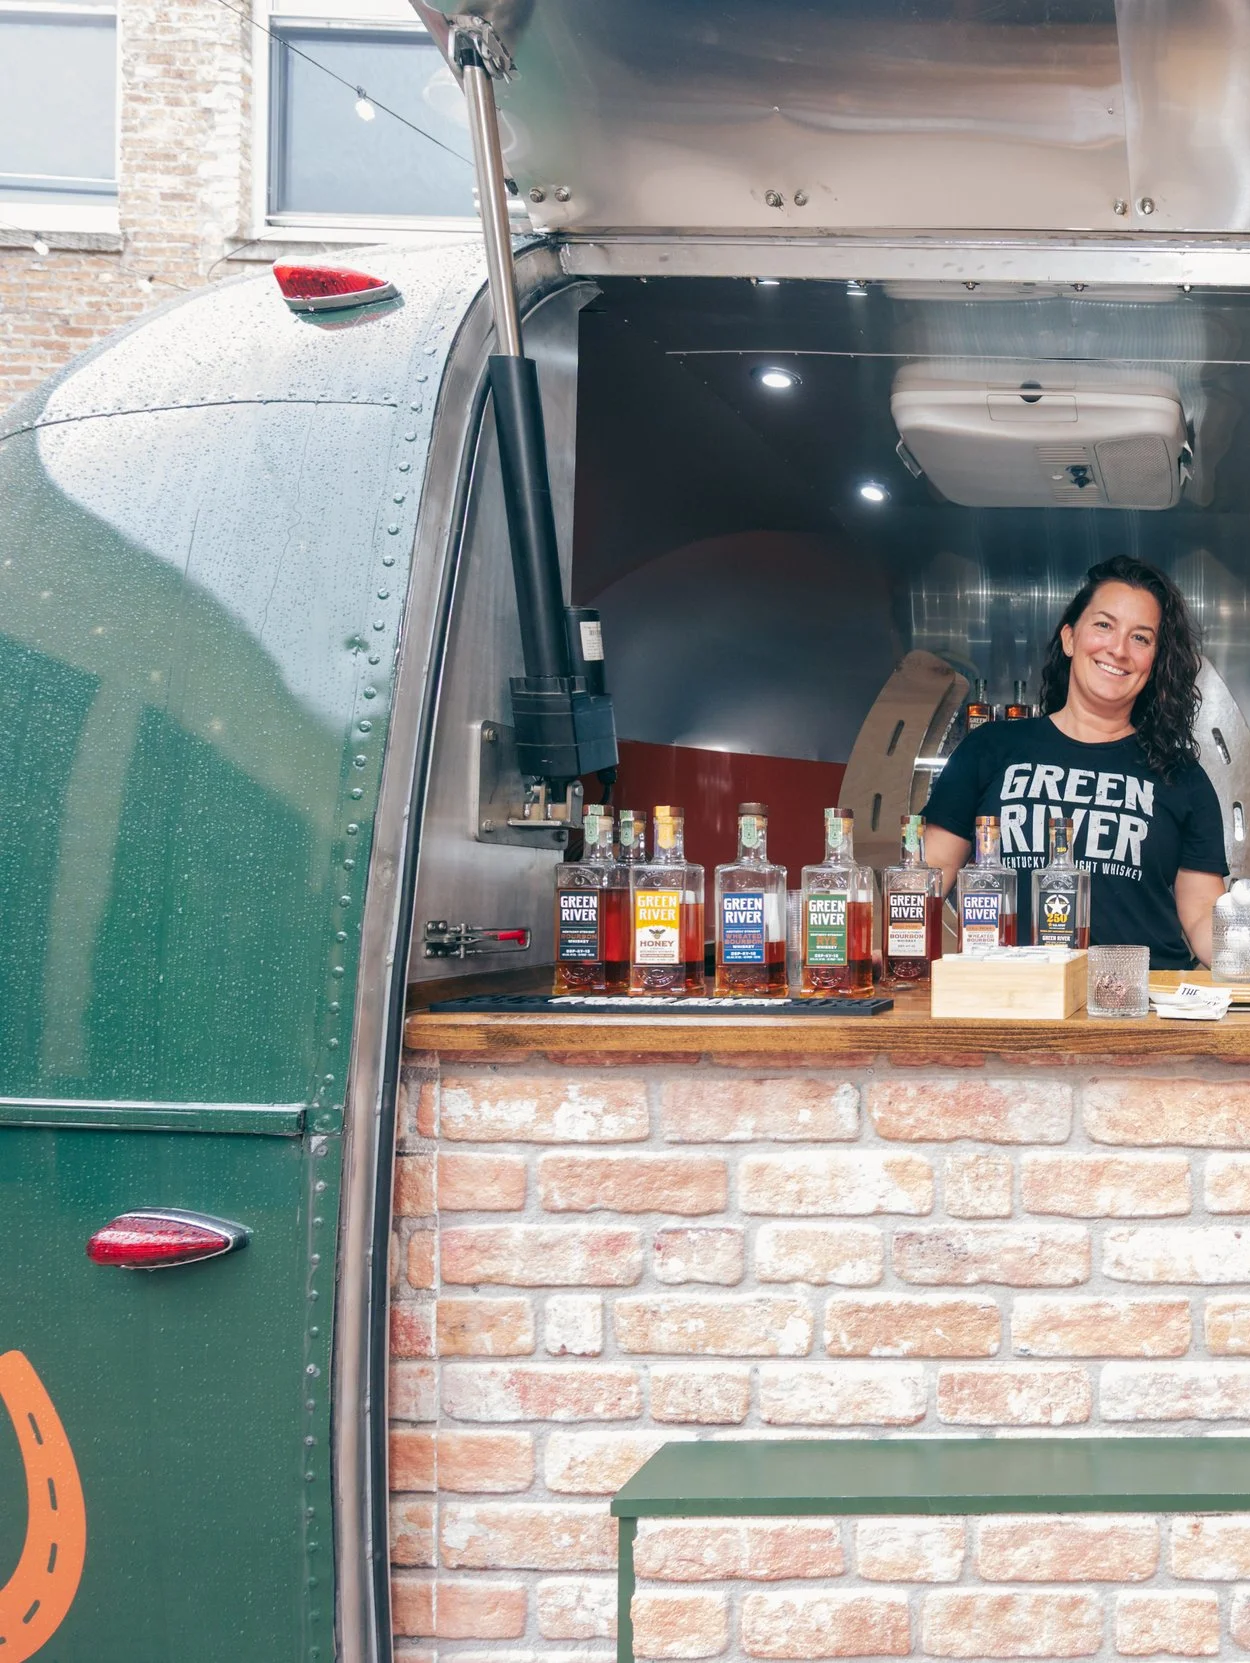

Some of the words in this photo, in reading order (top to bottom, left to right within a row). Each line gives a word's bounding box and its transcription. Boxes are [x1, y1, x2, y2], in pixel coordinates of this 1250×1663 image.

[1000, 763, 1154, 817] GREEN
[1001, 804, 1148, 866] RIVER
[1002, 856, 1045, 869] KENTUCKY
[1102, 862, 1143, 881] WHISKEY
[560, 896, 597, 908] GREEN
[637, 896, 676, 907] GREEN
[724, 898, 762, 910] GREEN
[809, 900, 846, 912] GREEN
[890, 895, 924, 906] GREEN
[964, 897, 997, 908] GREEN
[562, 909, 596, 921] RIVER
[640, 909, 676, 920] RIVER
[725, 911, 761, 923] RIVER
[891, 907, 923, 918] RIVER
[965, 909, 996, 919] RIVER
[1047, 914, 1067, 923] 250
[810, 913, 844, 925] RIVER
[816, 937, 837, 945] RYE
